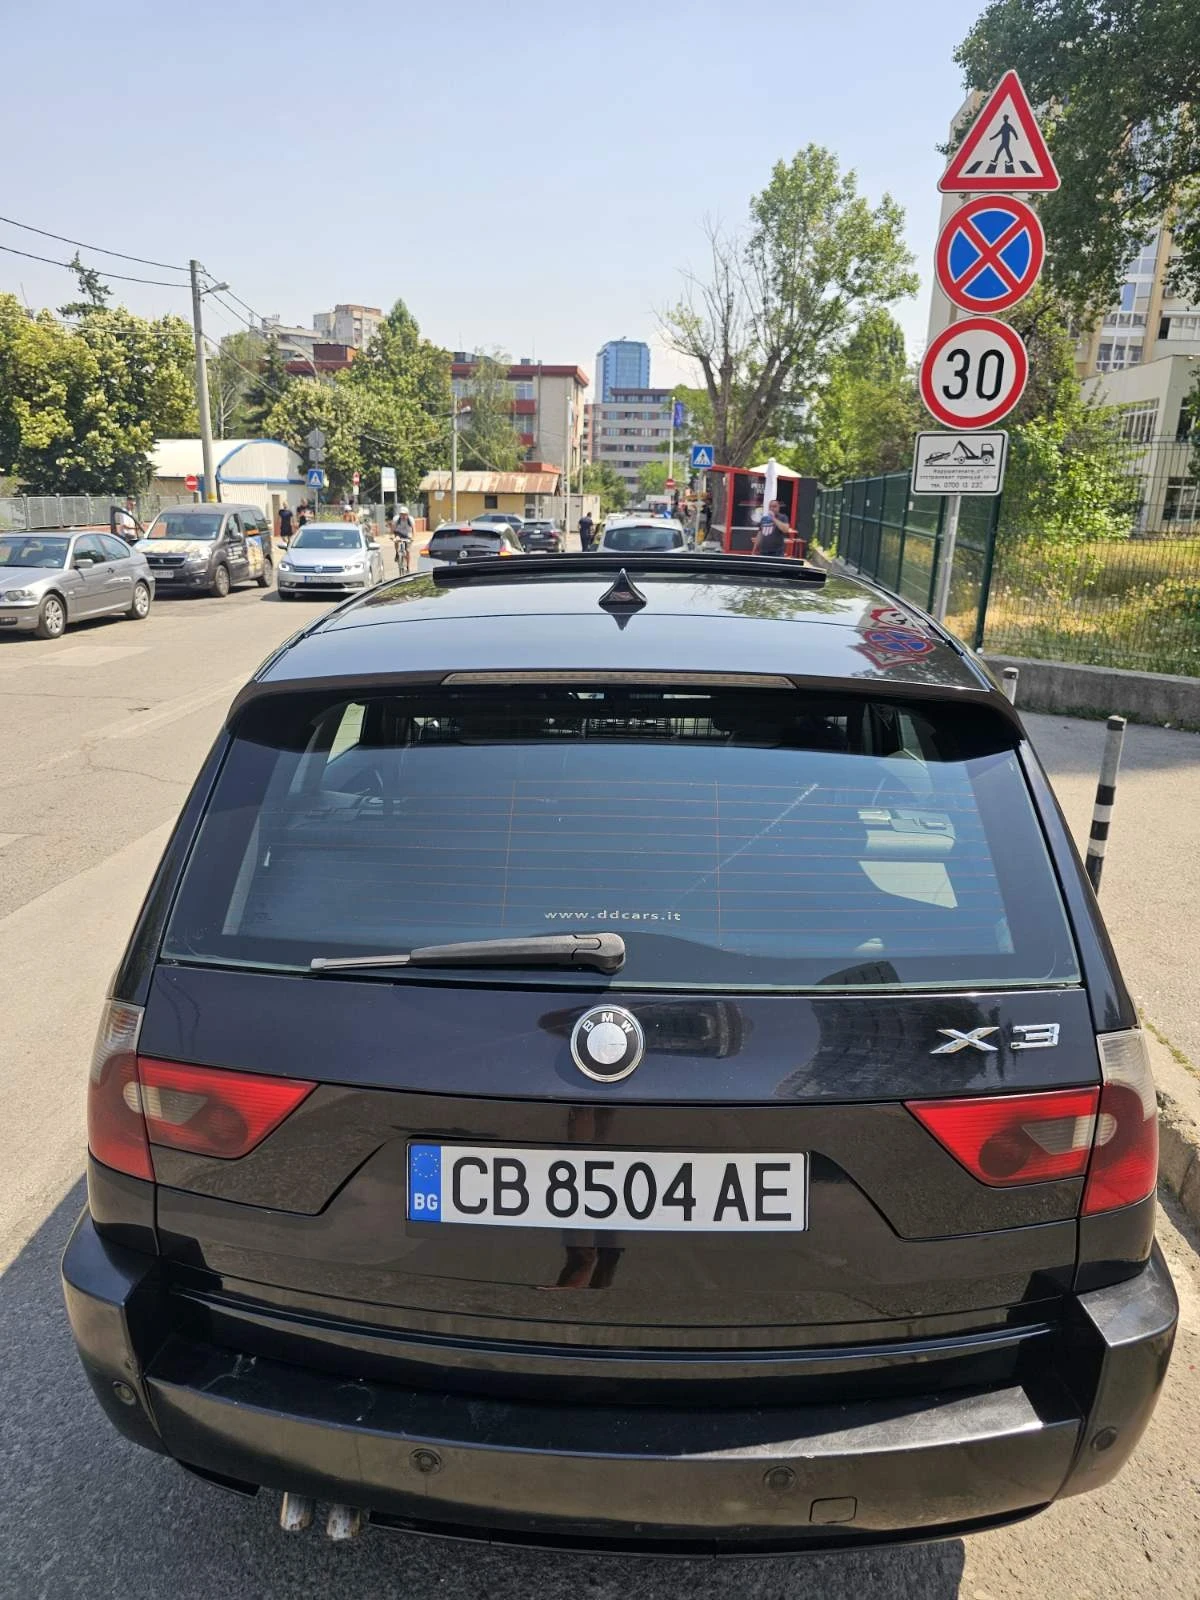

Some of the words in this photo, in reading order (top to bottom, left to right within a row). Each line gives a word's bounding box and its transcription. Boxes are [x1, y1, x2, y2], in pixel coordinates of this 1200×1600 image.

[942, 348, 1004, 401] 30
[544, 909, 681, 921] www.ddcars.it
[582, 1012, 634, 1034] BMW
[452, 1156, 530, 1217] CB
[545, 1159, 697, 1222] 8504
[713, 1162, 792, 1223] AE
[413, 1193, 438, 1211] BG
